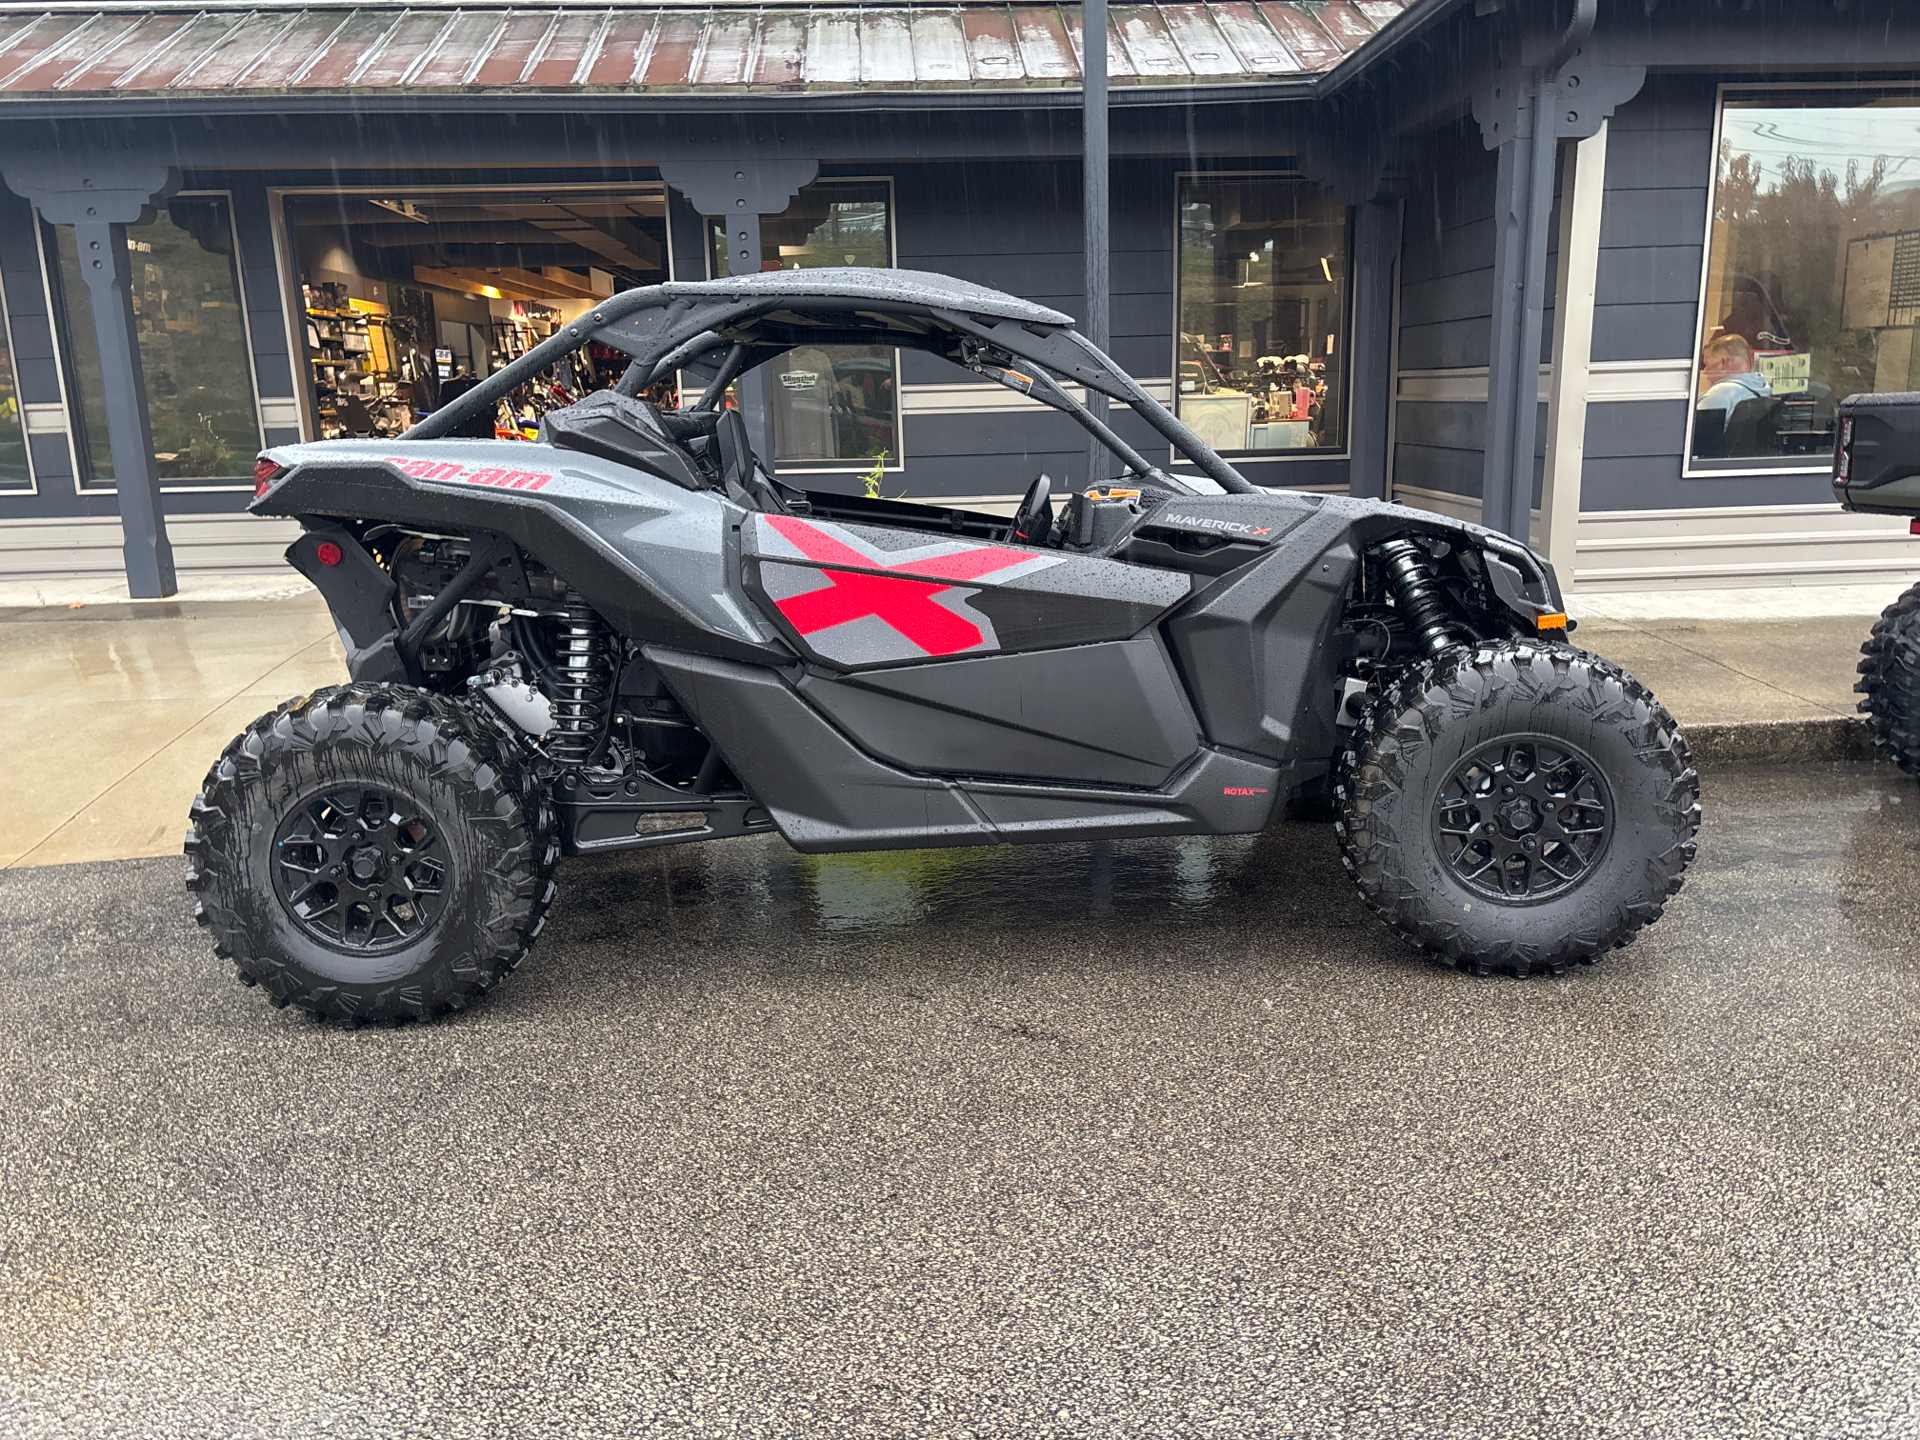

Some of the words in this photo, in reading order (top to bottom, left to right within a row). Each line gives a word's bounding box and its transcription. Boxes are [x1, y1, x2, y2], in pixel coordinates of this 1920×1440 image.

[783, 374, 816, 383] Slingshot
[1165, 513, 1252, 534] MAVERICK
[1252, 526, 1272, 535] X
[1223, 786, 1254, 796] ROTAX
